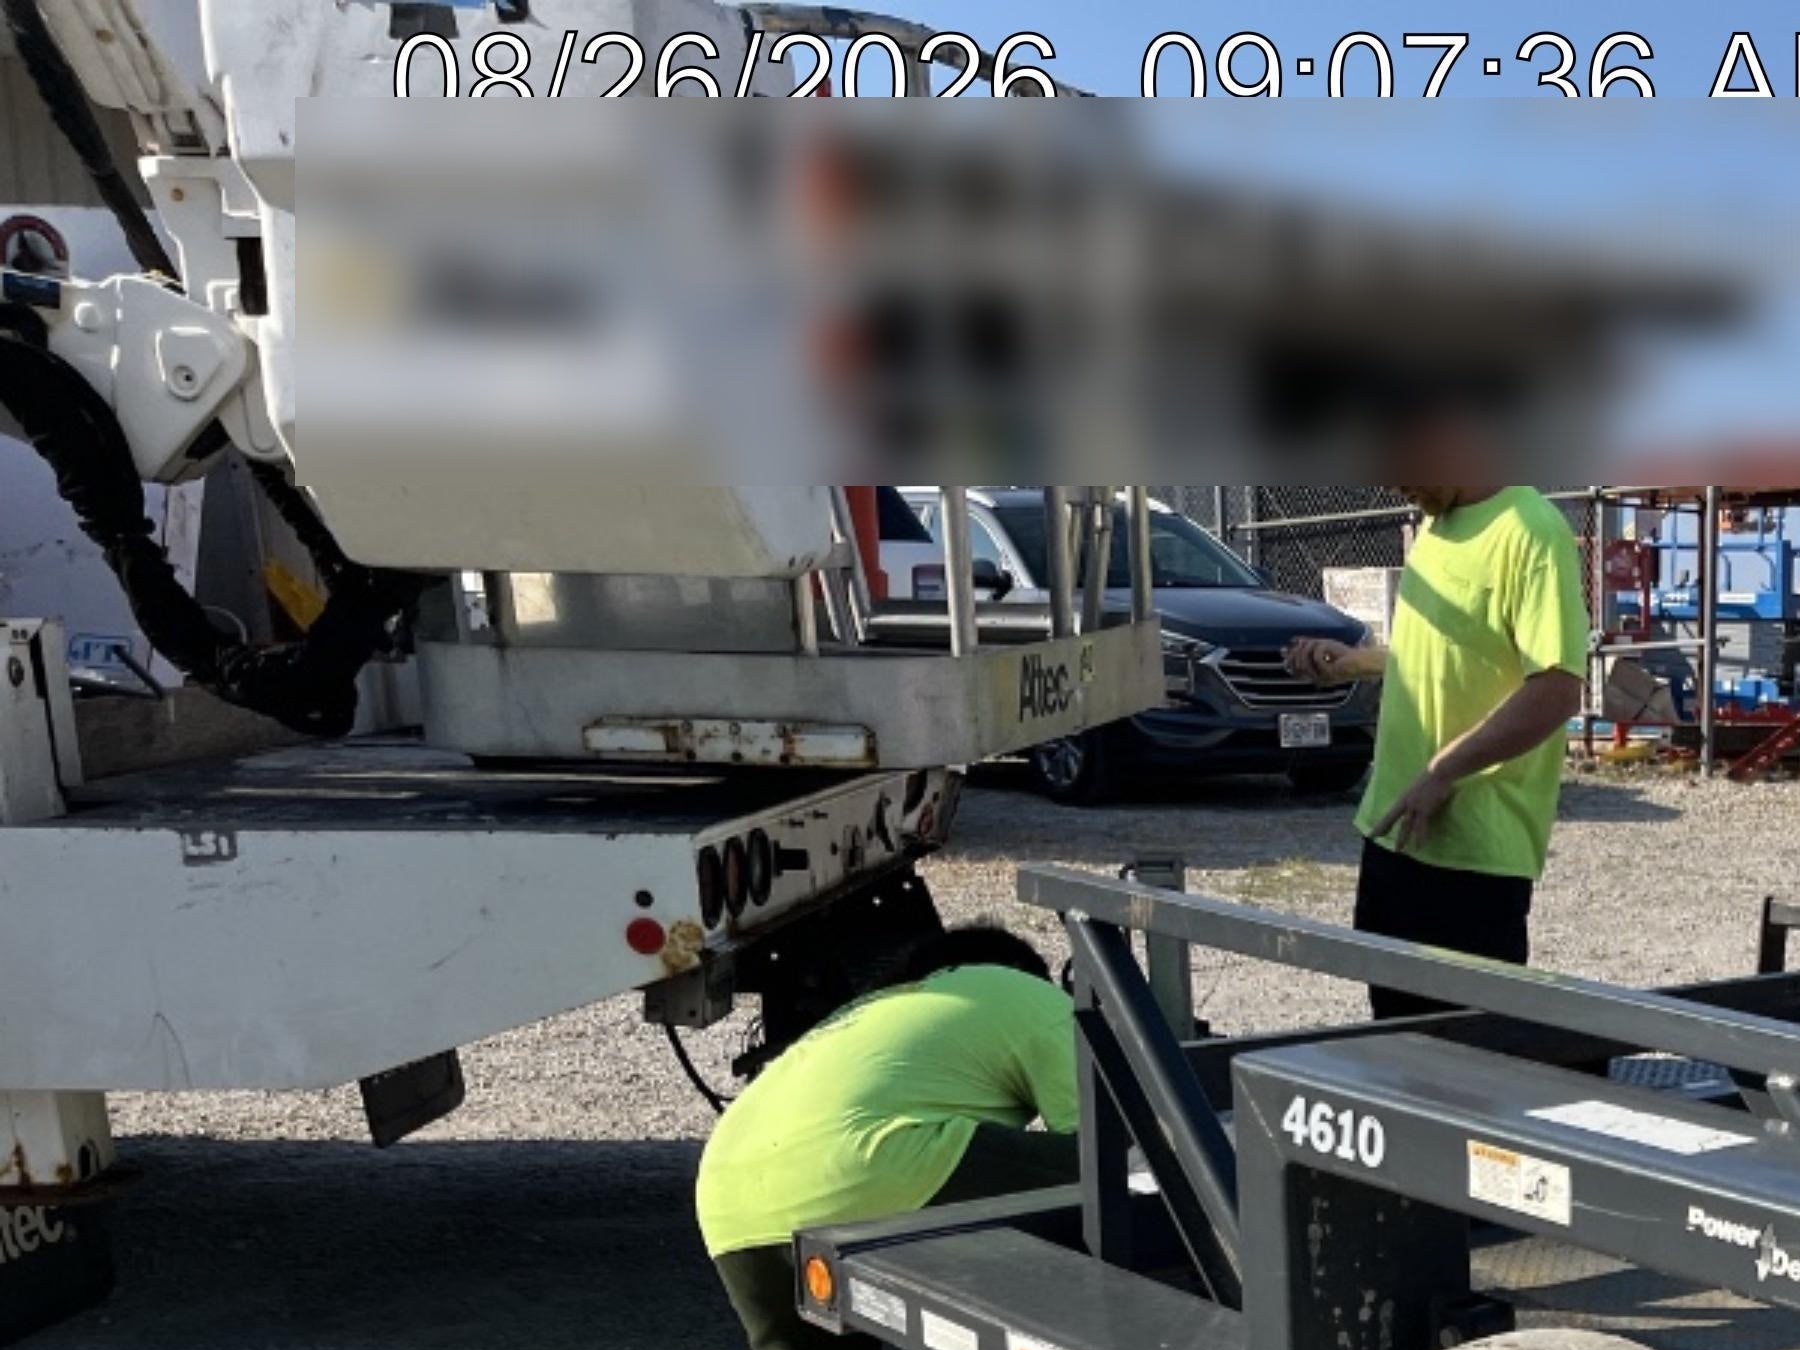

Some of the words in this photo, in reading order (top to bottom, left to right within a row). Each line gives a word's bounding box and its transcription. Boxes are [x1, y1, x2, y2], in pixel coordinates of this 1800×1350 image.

[1019, 653, 1073, 723] Altec
[1282, 1095, 1385, 1168] 4610
[0, 1205, 63, 1264] tec
[1685, 1205, 1761, 1249] Power
